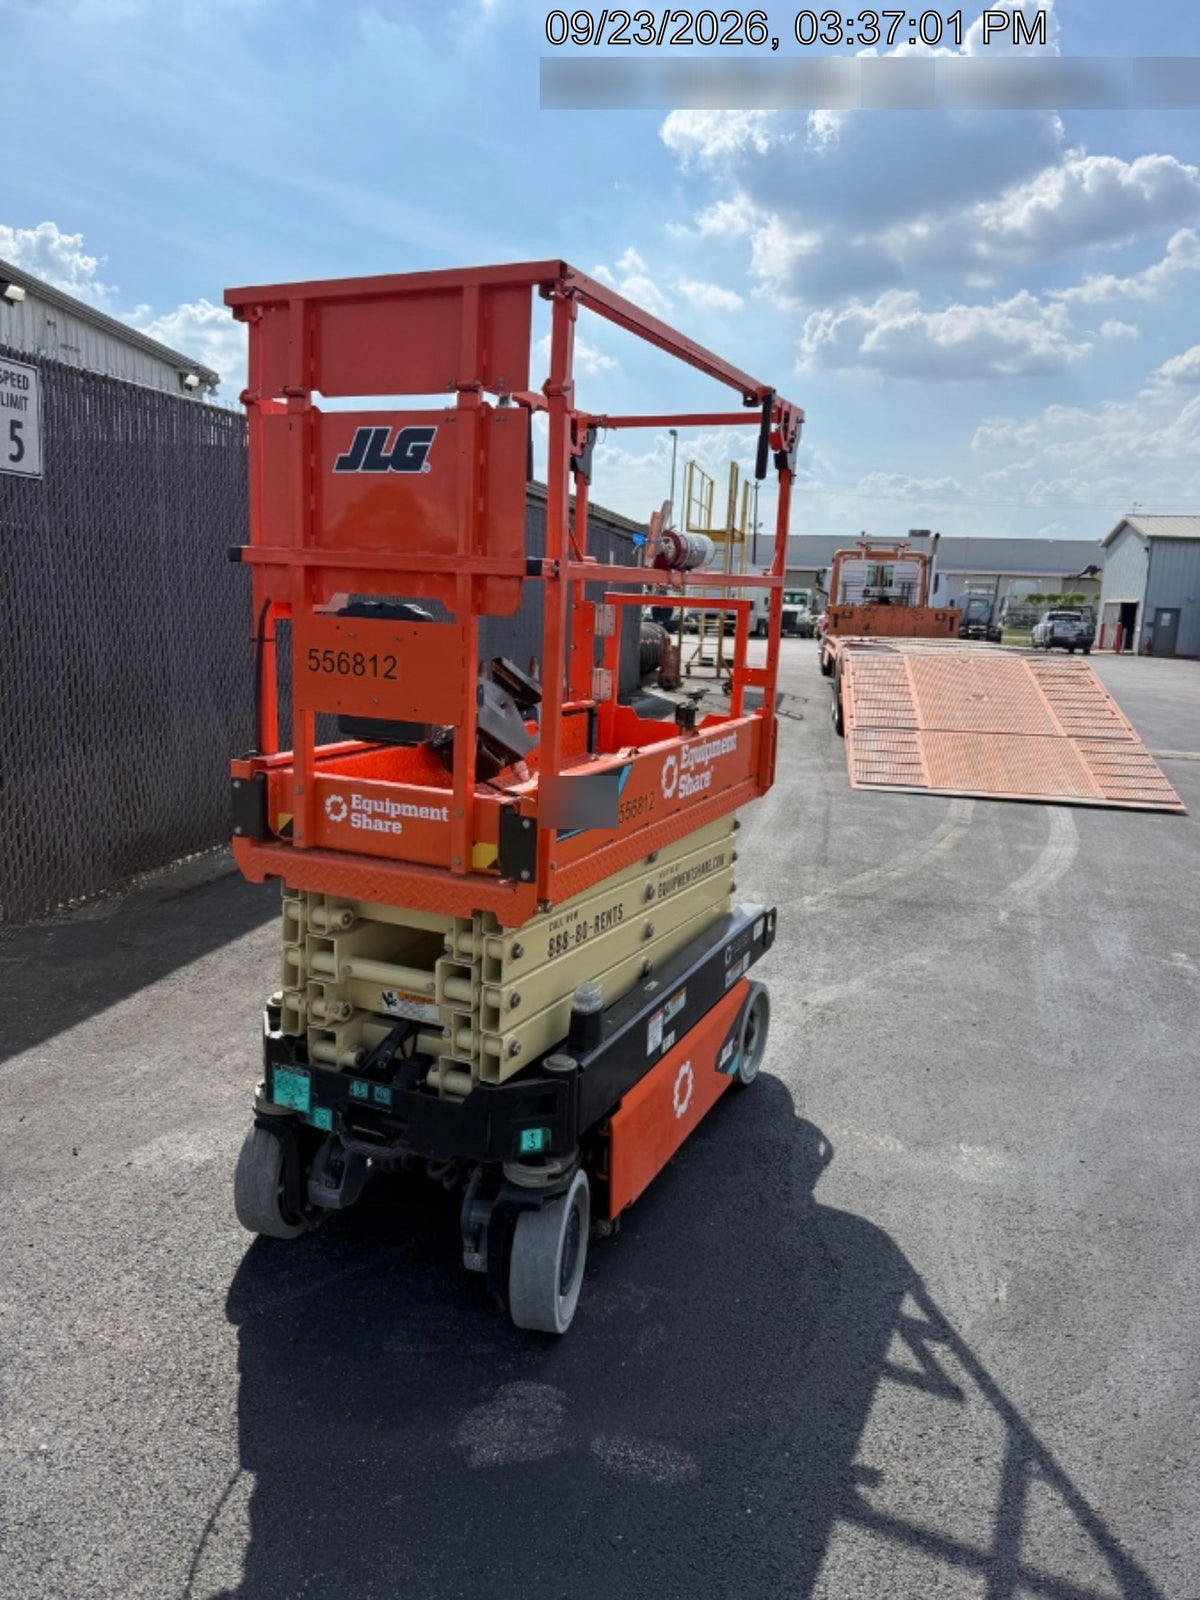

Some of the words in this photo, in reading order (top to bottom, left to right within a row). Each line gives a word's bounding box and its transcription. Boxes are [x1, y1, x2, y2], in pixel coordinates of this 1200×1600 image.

[0, 390, 29, 411] LIMIT
[8, 419, 25, 462] 5
[332, 426, 438, 473] JLG
[308, 648, 398, 680] 556812
[680, 733, 738, 770] Equipment
[678, 771, 711, 798] Share
[350, 793, 450, 822] Equipment
[619, 791, 655, 823] 556812
[351, 813, 403, 834] Share
[548, 902, 624, 957] 888-80-RENTS
